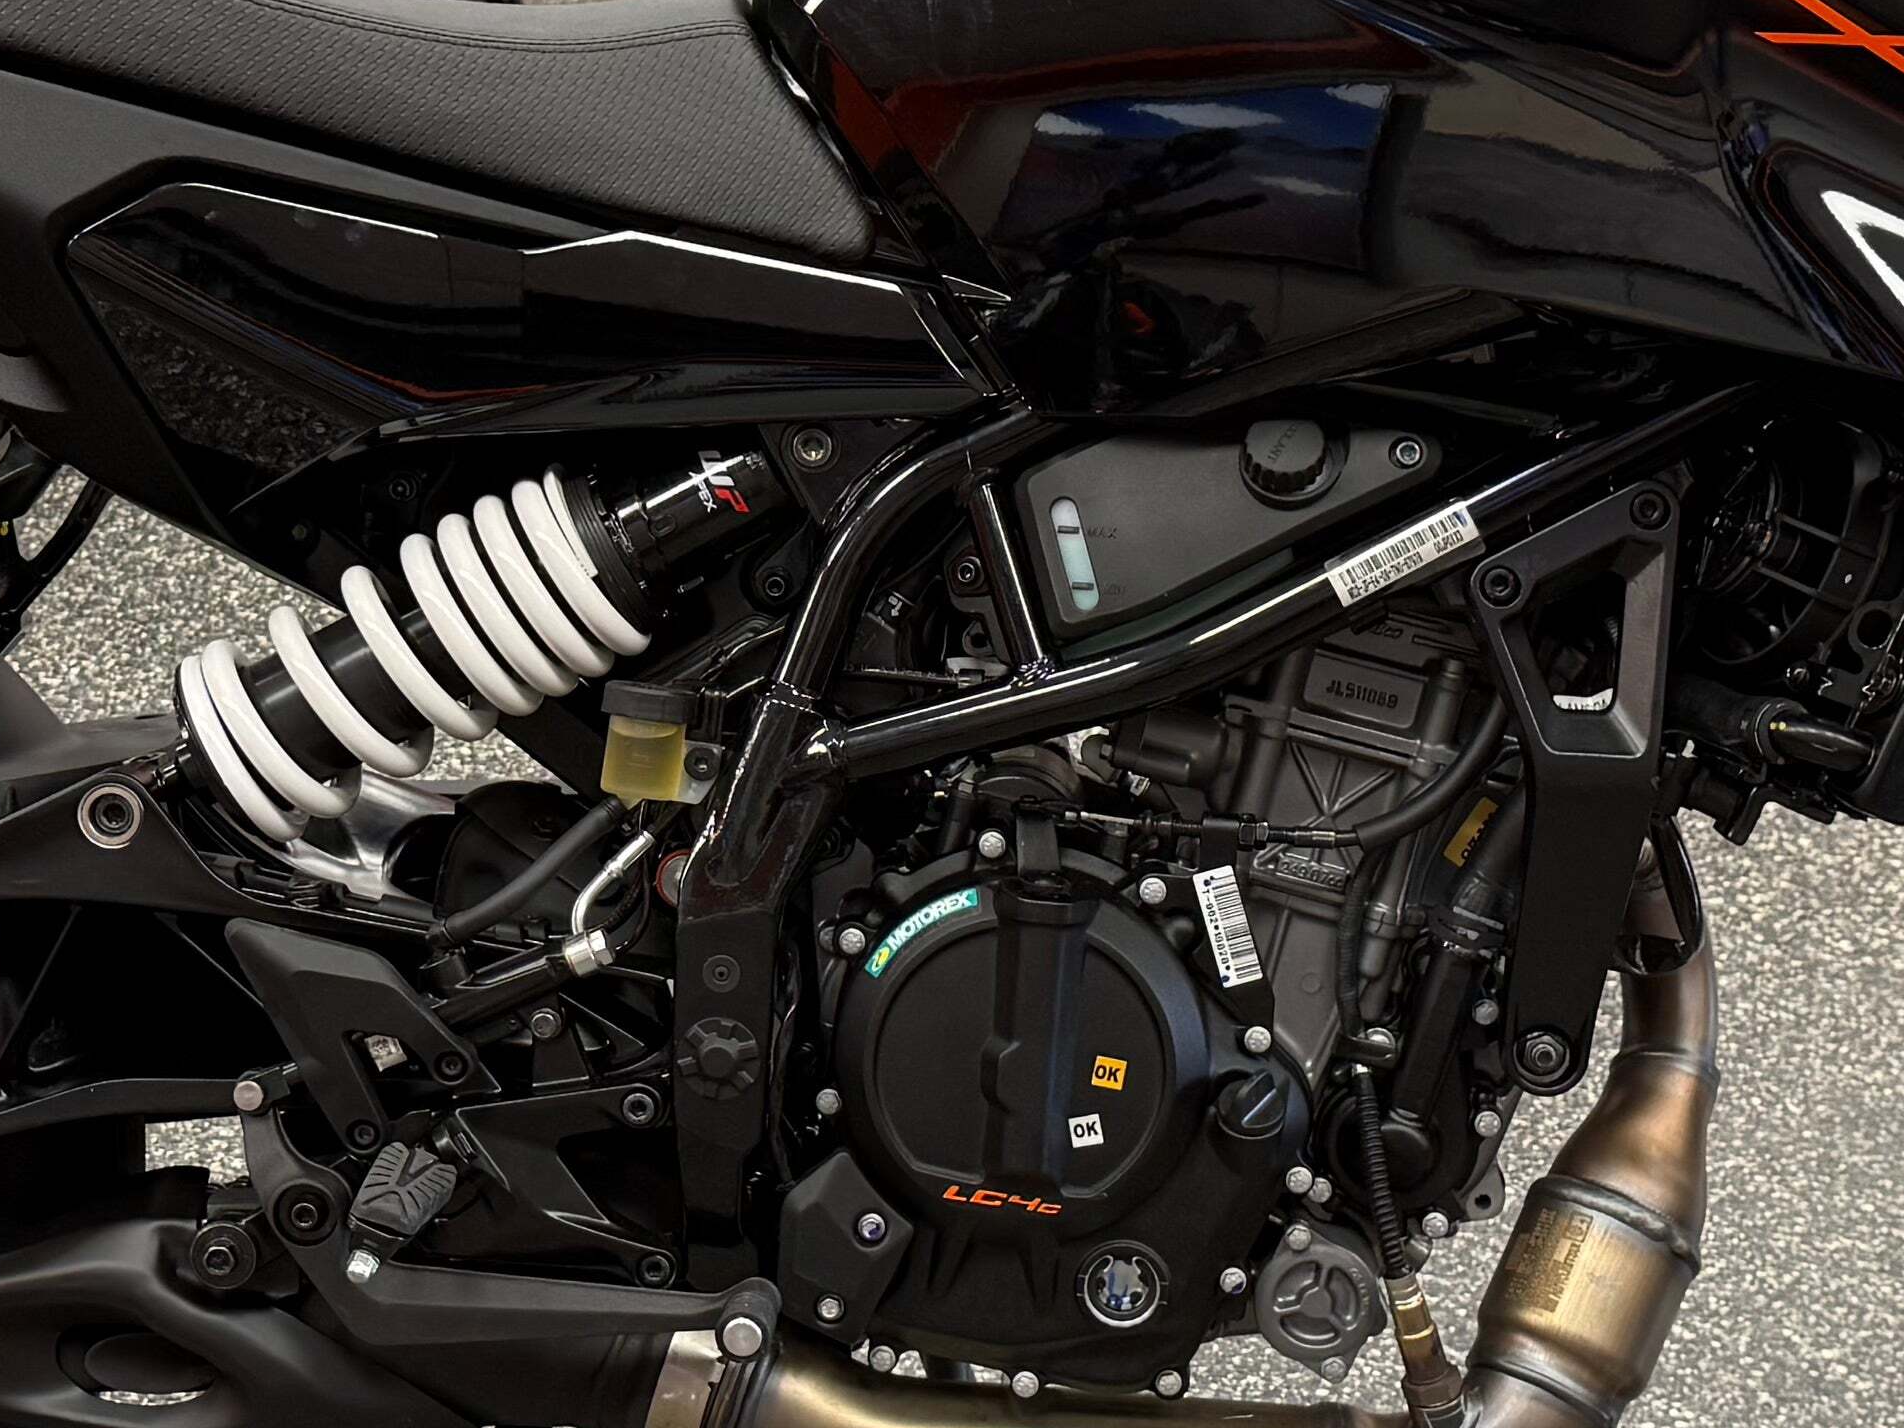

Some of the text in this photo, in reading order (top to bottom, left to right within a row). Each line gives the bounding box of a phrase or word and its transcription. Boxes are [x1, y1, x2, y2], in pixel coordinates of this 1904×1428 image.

[887, 889, 972, 949] MOTOREX
[1095, 1064, 1121, 1083] OK
[1073, 1121, 1098, 1138] OK
